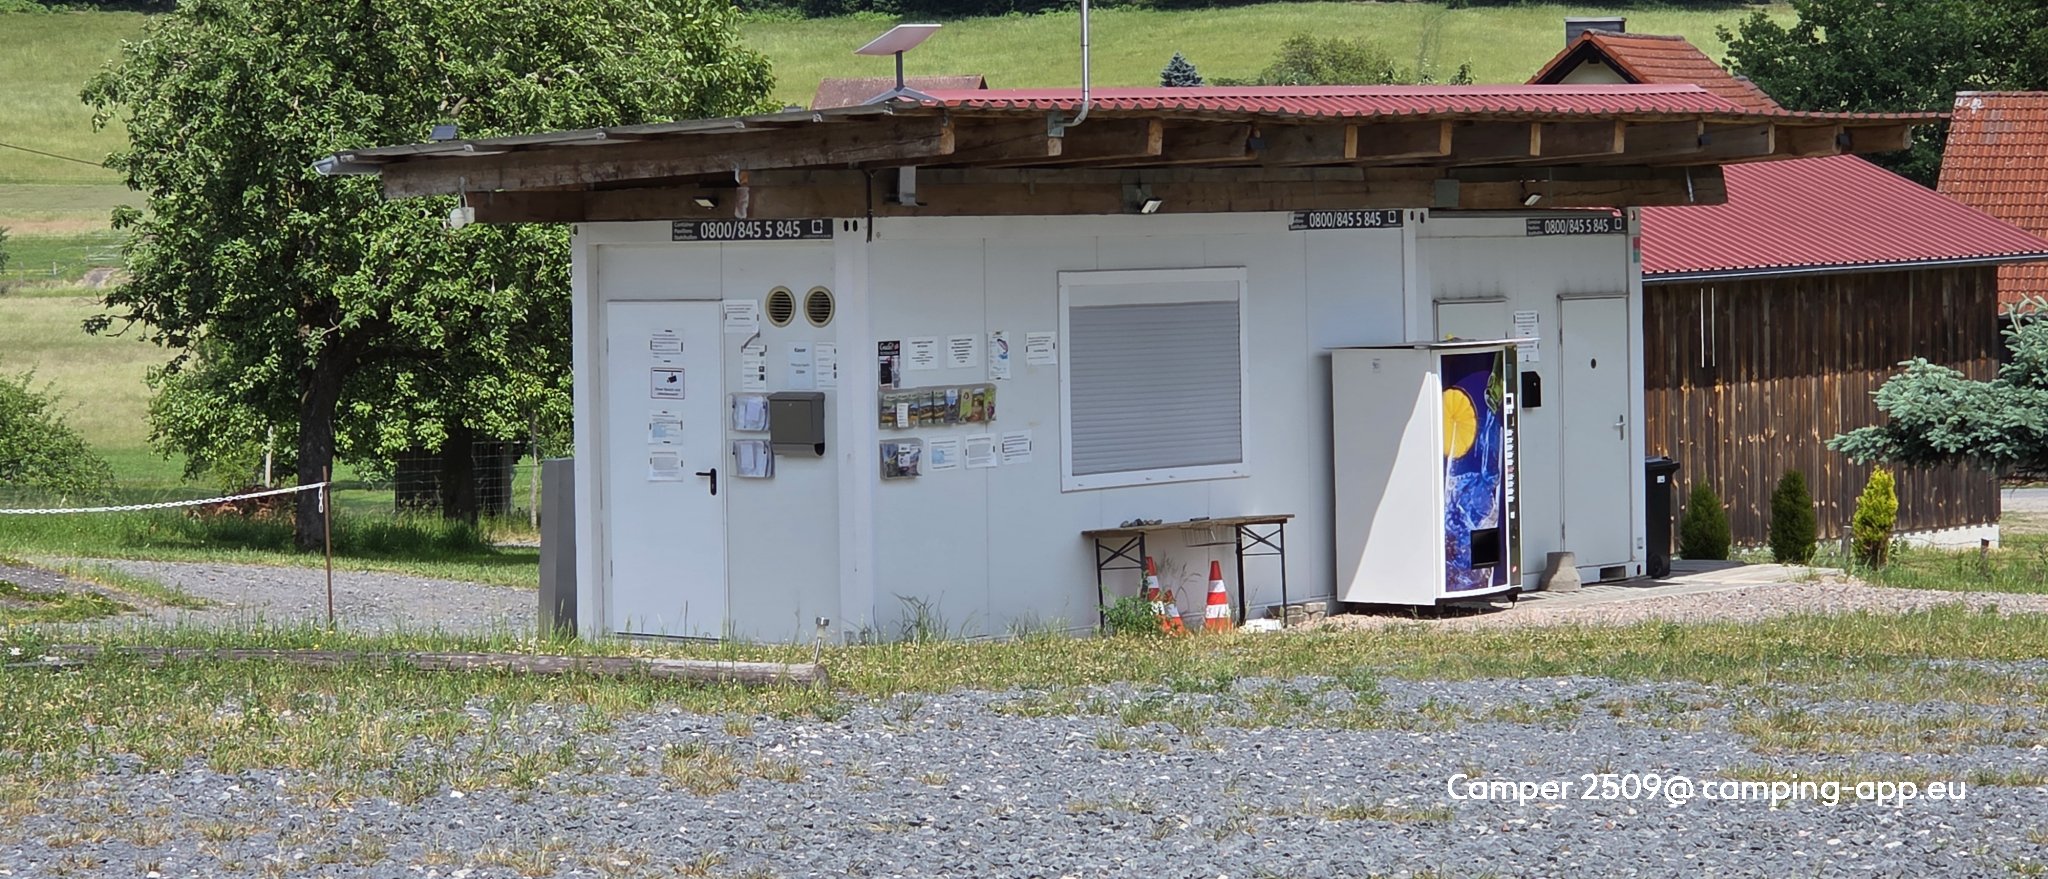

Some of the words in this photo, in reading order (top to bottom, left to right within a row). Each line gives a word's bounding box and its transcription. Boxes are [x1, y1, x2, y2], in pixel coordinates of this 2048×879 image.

[1309, 212, 1353, 227] 0800/845
[1356, 212, 1362, 226] 5
[1364, 211, 1381, 226] 845
[1544, 219, 1583, 235] 0800/845
[1586, 219, 1591, 233] 5
[1593, 218, 1609, 233] 845
[700, 221, 762, 240] 0800/845
[765, 221, 773, 238] 5
[776, 220, 801, 238] 845
